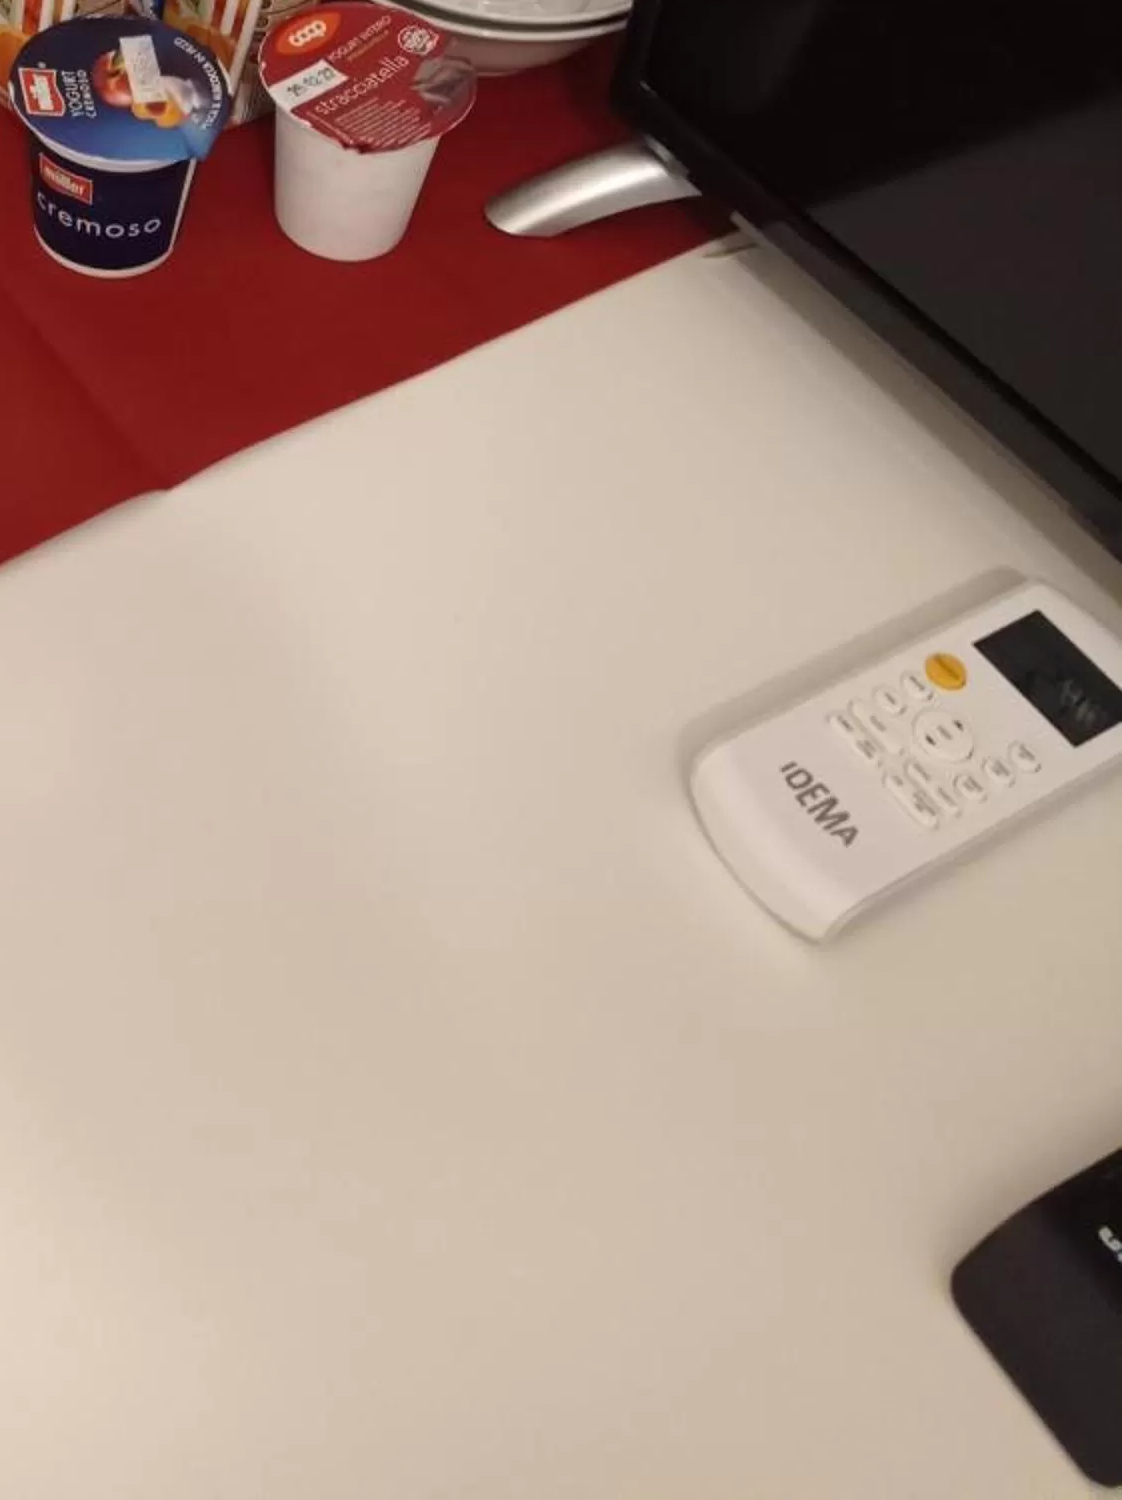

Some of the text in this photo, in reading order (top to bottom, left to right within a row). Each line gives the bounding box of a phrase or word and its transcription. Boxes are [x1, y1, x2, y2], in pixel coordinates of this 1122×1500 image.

[61, 70, 83, 118] YOGURT
[315, 55, 410, 115] stracciatella
[37, 191, 162, 238] cremoso
